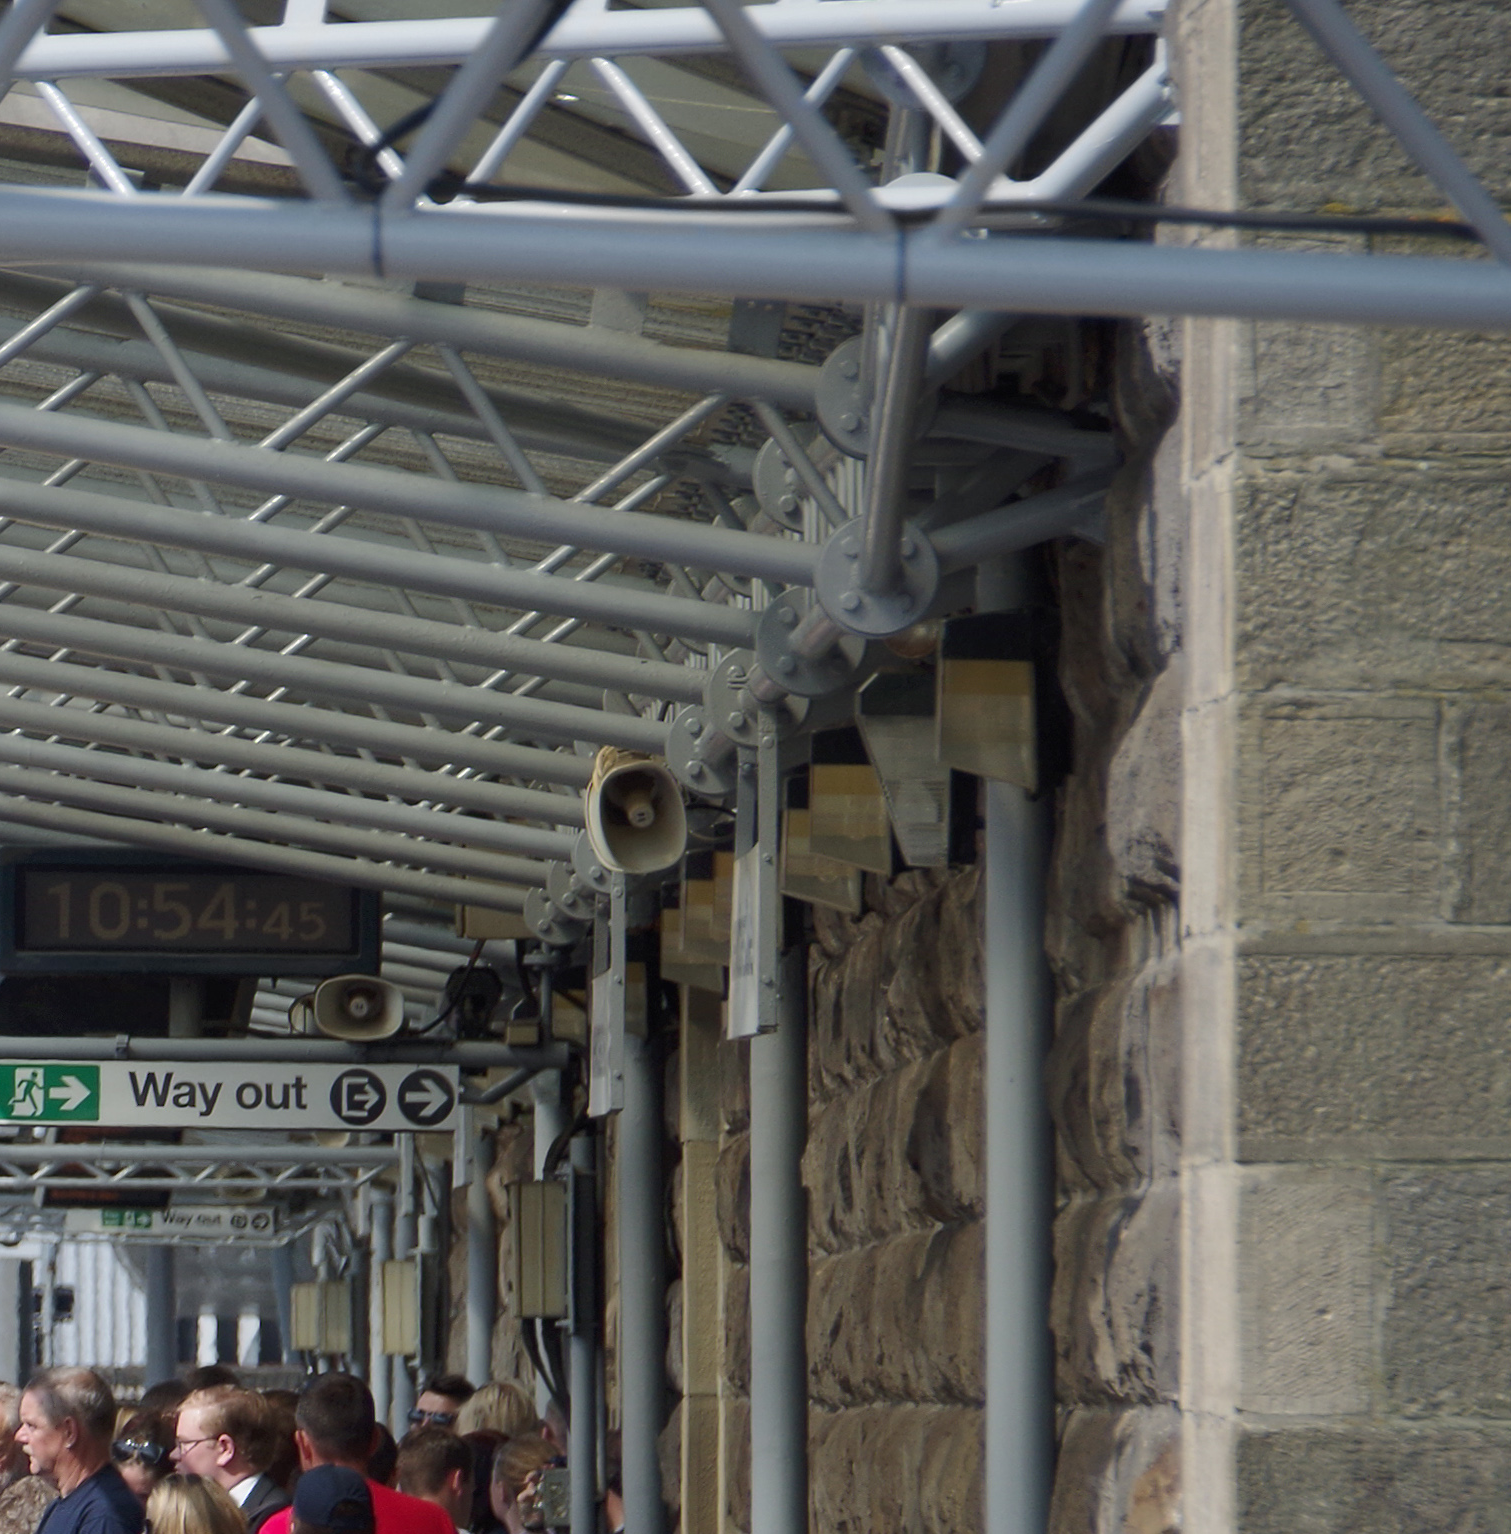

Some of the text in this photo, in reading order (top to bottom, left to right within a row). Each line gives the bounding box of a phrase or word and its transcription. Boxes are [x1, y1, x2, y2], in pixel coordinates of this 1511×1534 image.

[48, 881, 326, 941] 10:54:45
[128, 1071, 308, 1117] Way out
